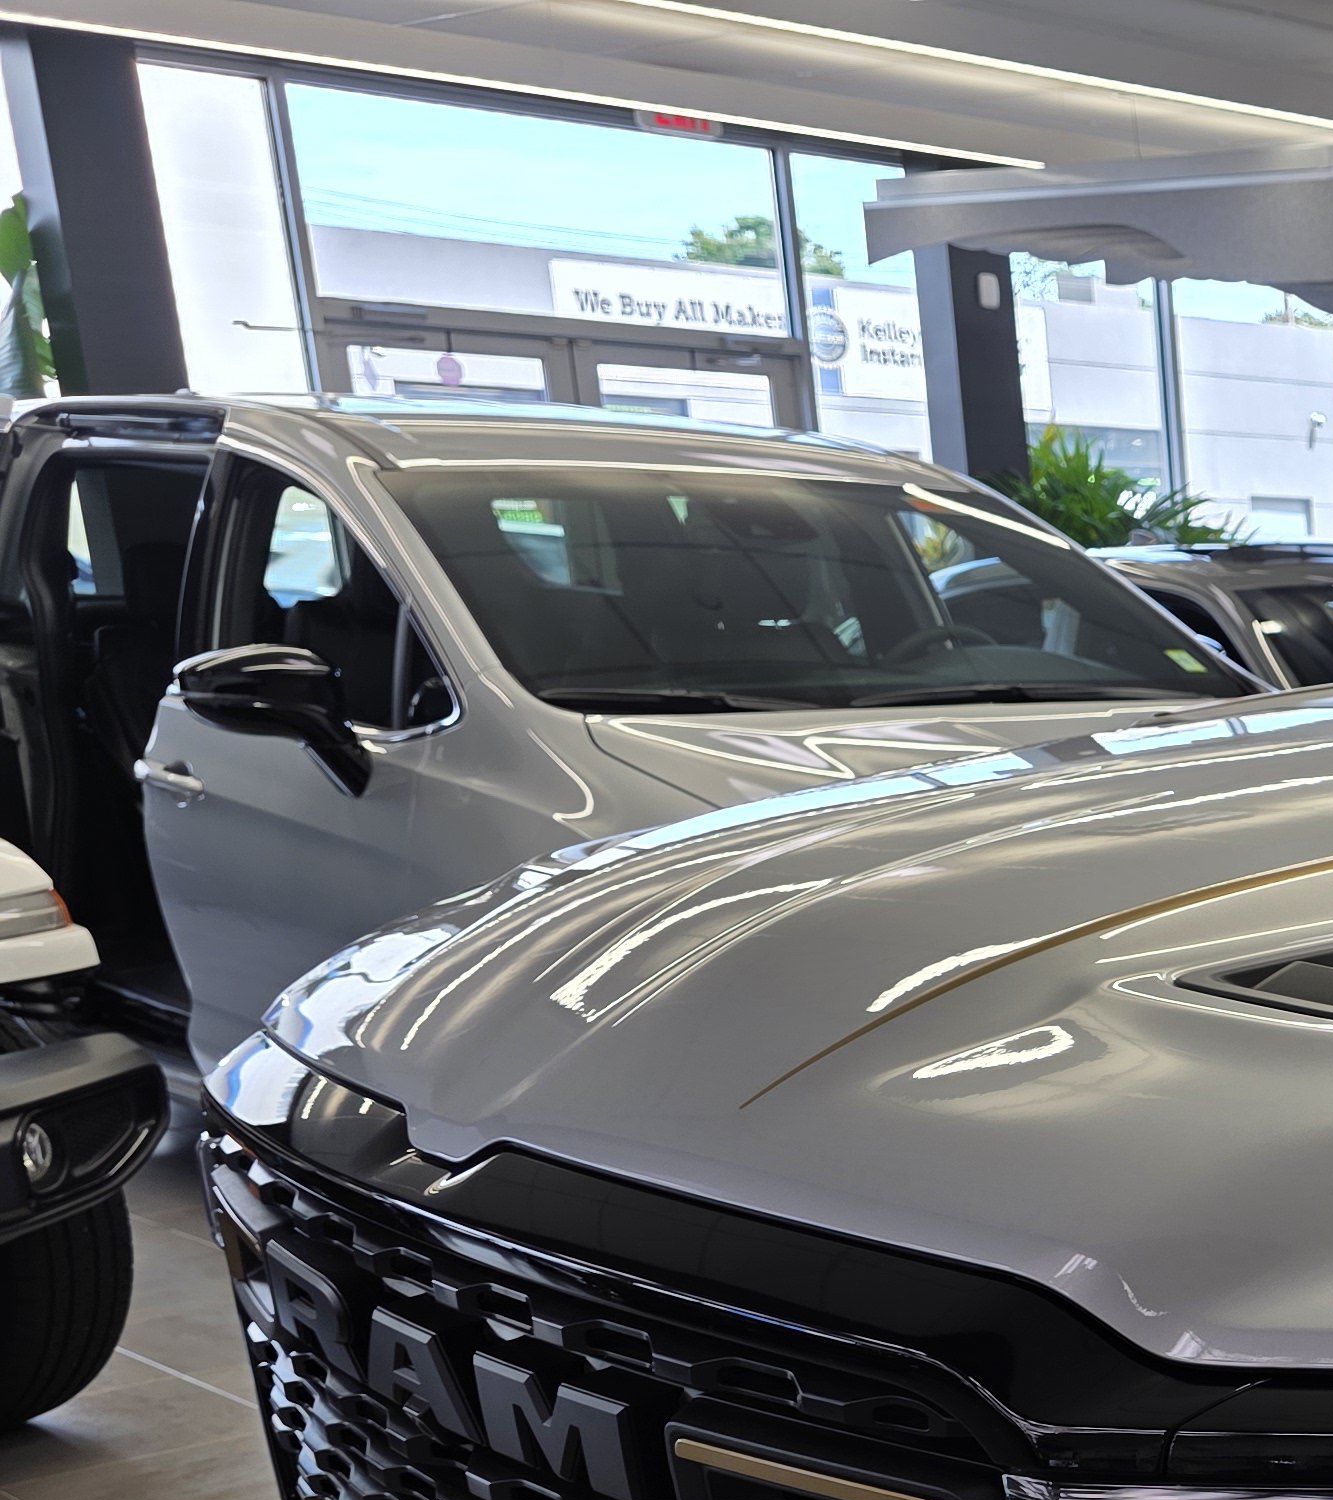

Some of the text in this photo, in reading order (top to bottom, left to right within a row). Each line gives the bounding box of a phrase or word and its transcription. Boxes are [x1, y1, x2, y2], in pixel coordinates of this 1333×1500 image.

[573, 288, 613, 314] We
[618, 291, 667, 323] Buy
[674, 297, 705, 323] All
[857, 317, 920, 347] Kelley
